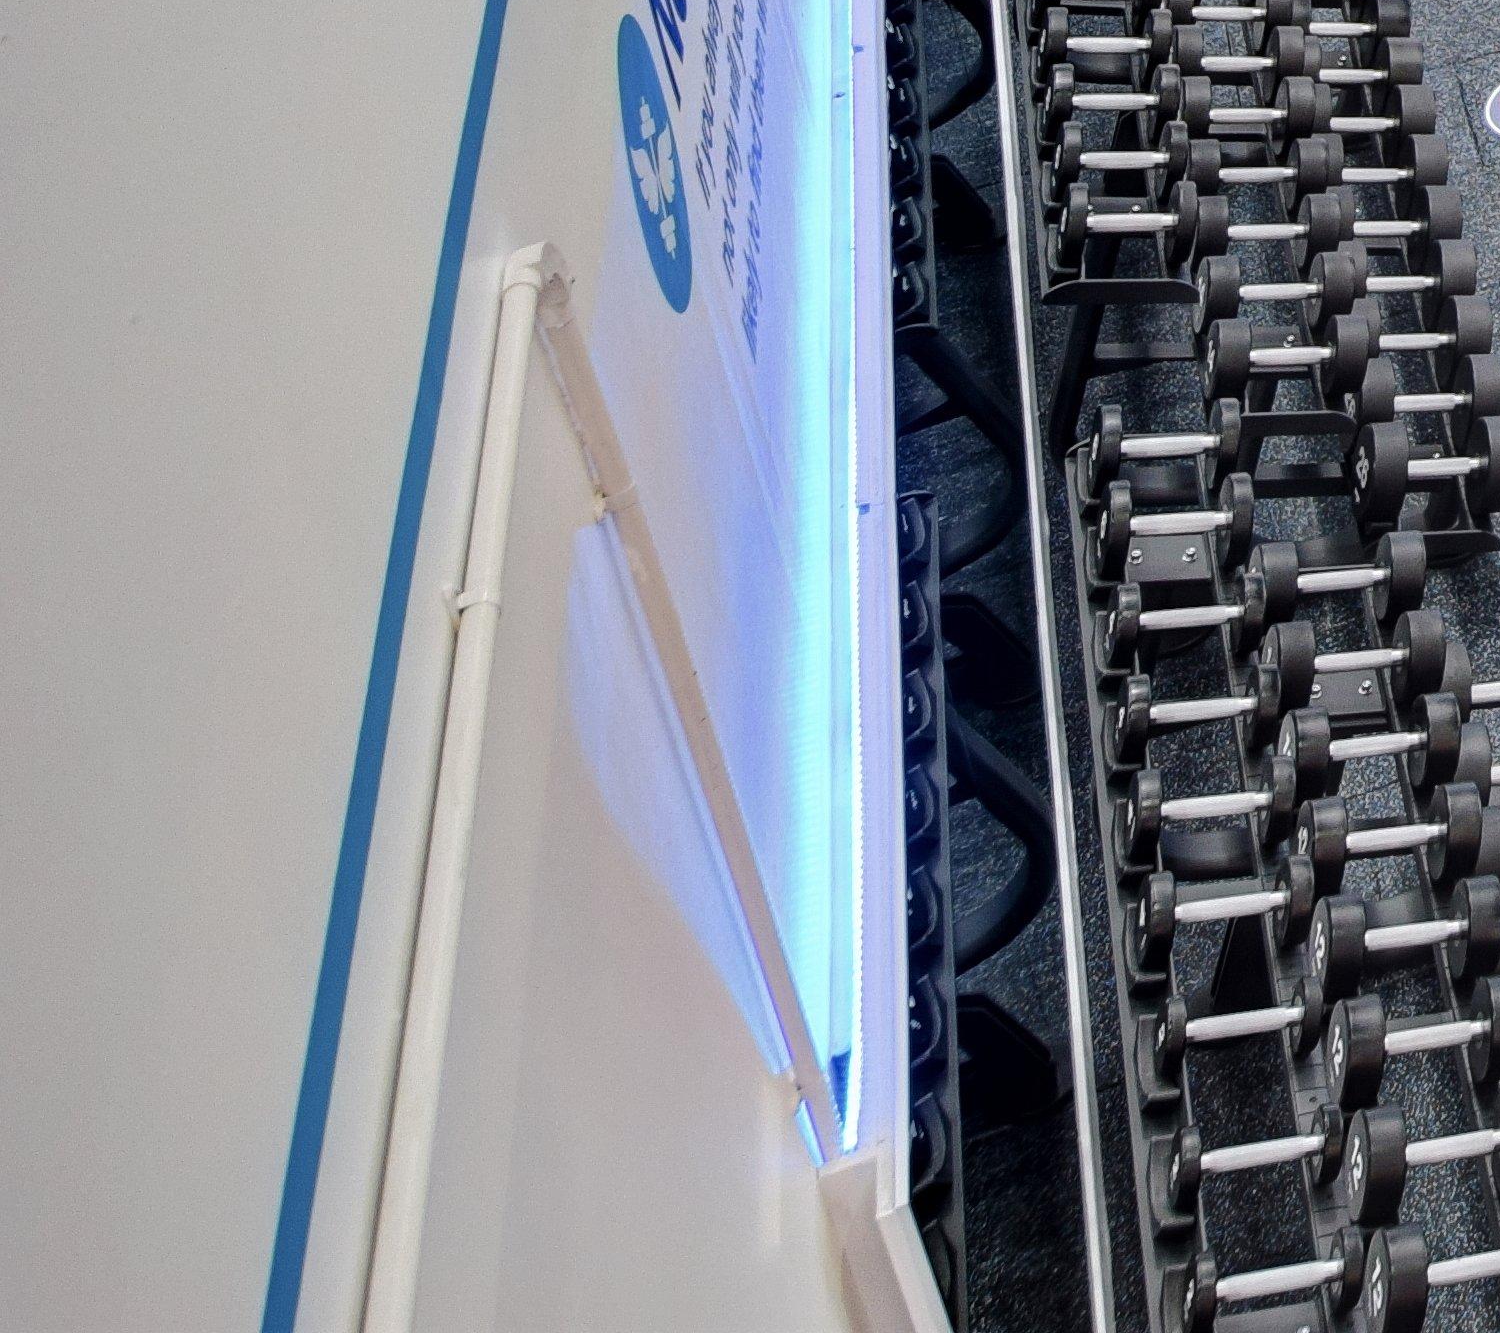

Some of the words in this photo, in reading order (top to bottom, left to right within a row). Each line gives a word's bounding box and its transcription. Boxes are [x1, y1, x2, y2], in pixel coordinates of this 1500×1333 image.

[725, 34, 741, 126] will
[699, 81, 718, 190] you
[721, 101, 742, 225] only
[720, 192, 735, 286] not
